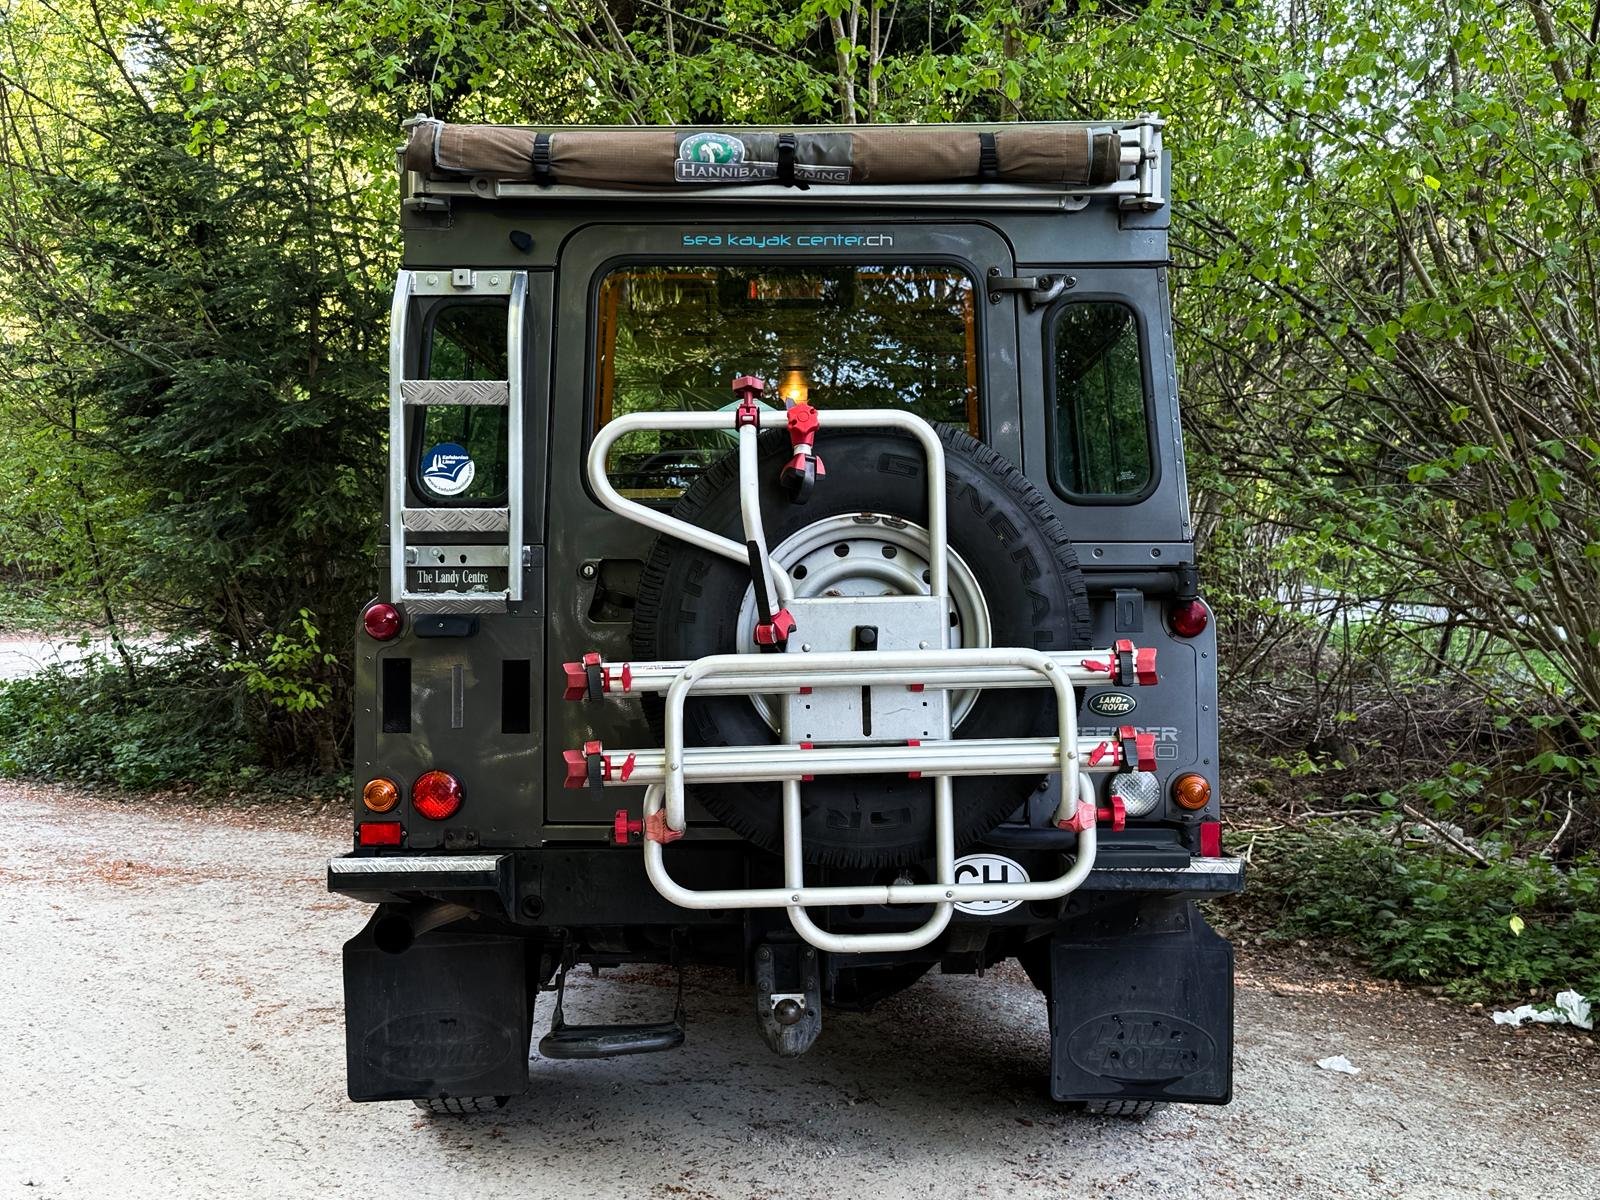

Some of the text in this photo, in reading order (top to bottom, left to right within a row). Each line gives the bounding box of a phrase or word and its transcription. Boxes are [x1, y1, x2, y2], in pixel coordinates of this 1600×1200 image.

[682, 163, 845, 180] HANNIBAL WNING
[683, 233, 893, 248] sea kayak center.ch
[417, 569, 489, 587] The Landy Centre
[1099, 696, 1122, 704] LAND
[1101, 703, 1130, 711] ROVER
[1077, 727, 1178, 741] FEER
[954, 864, 1008, 904] CH
[1095, 1023, 1171, 1046] LAND
[1102, 1046, 1200, 1070] ROVER
